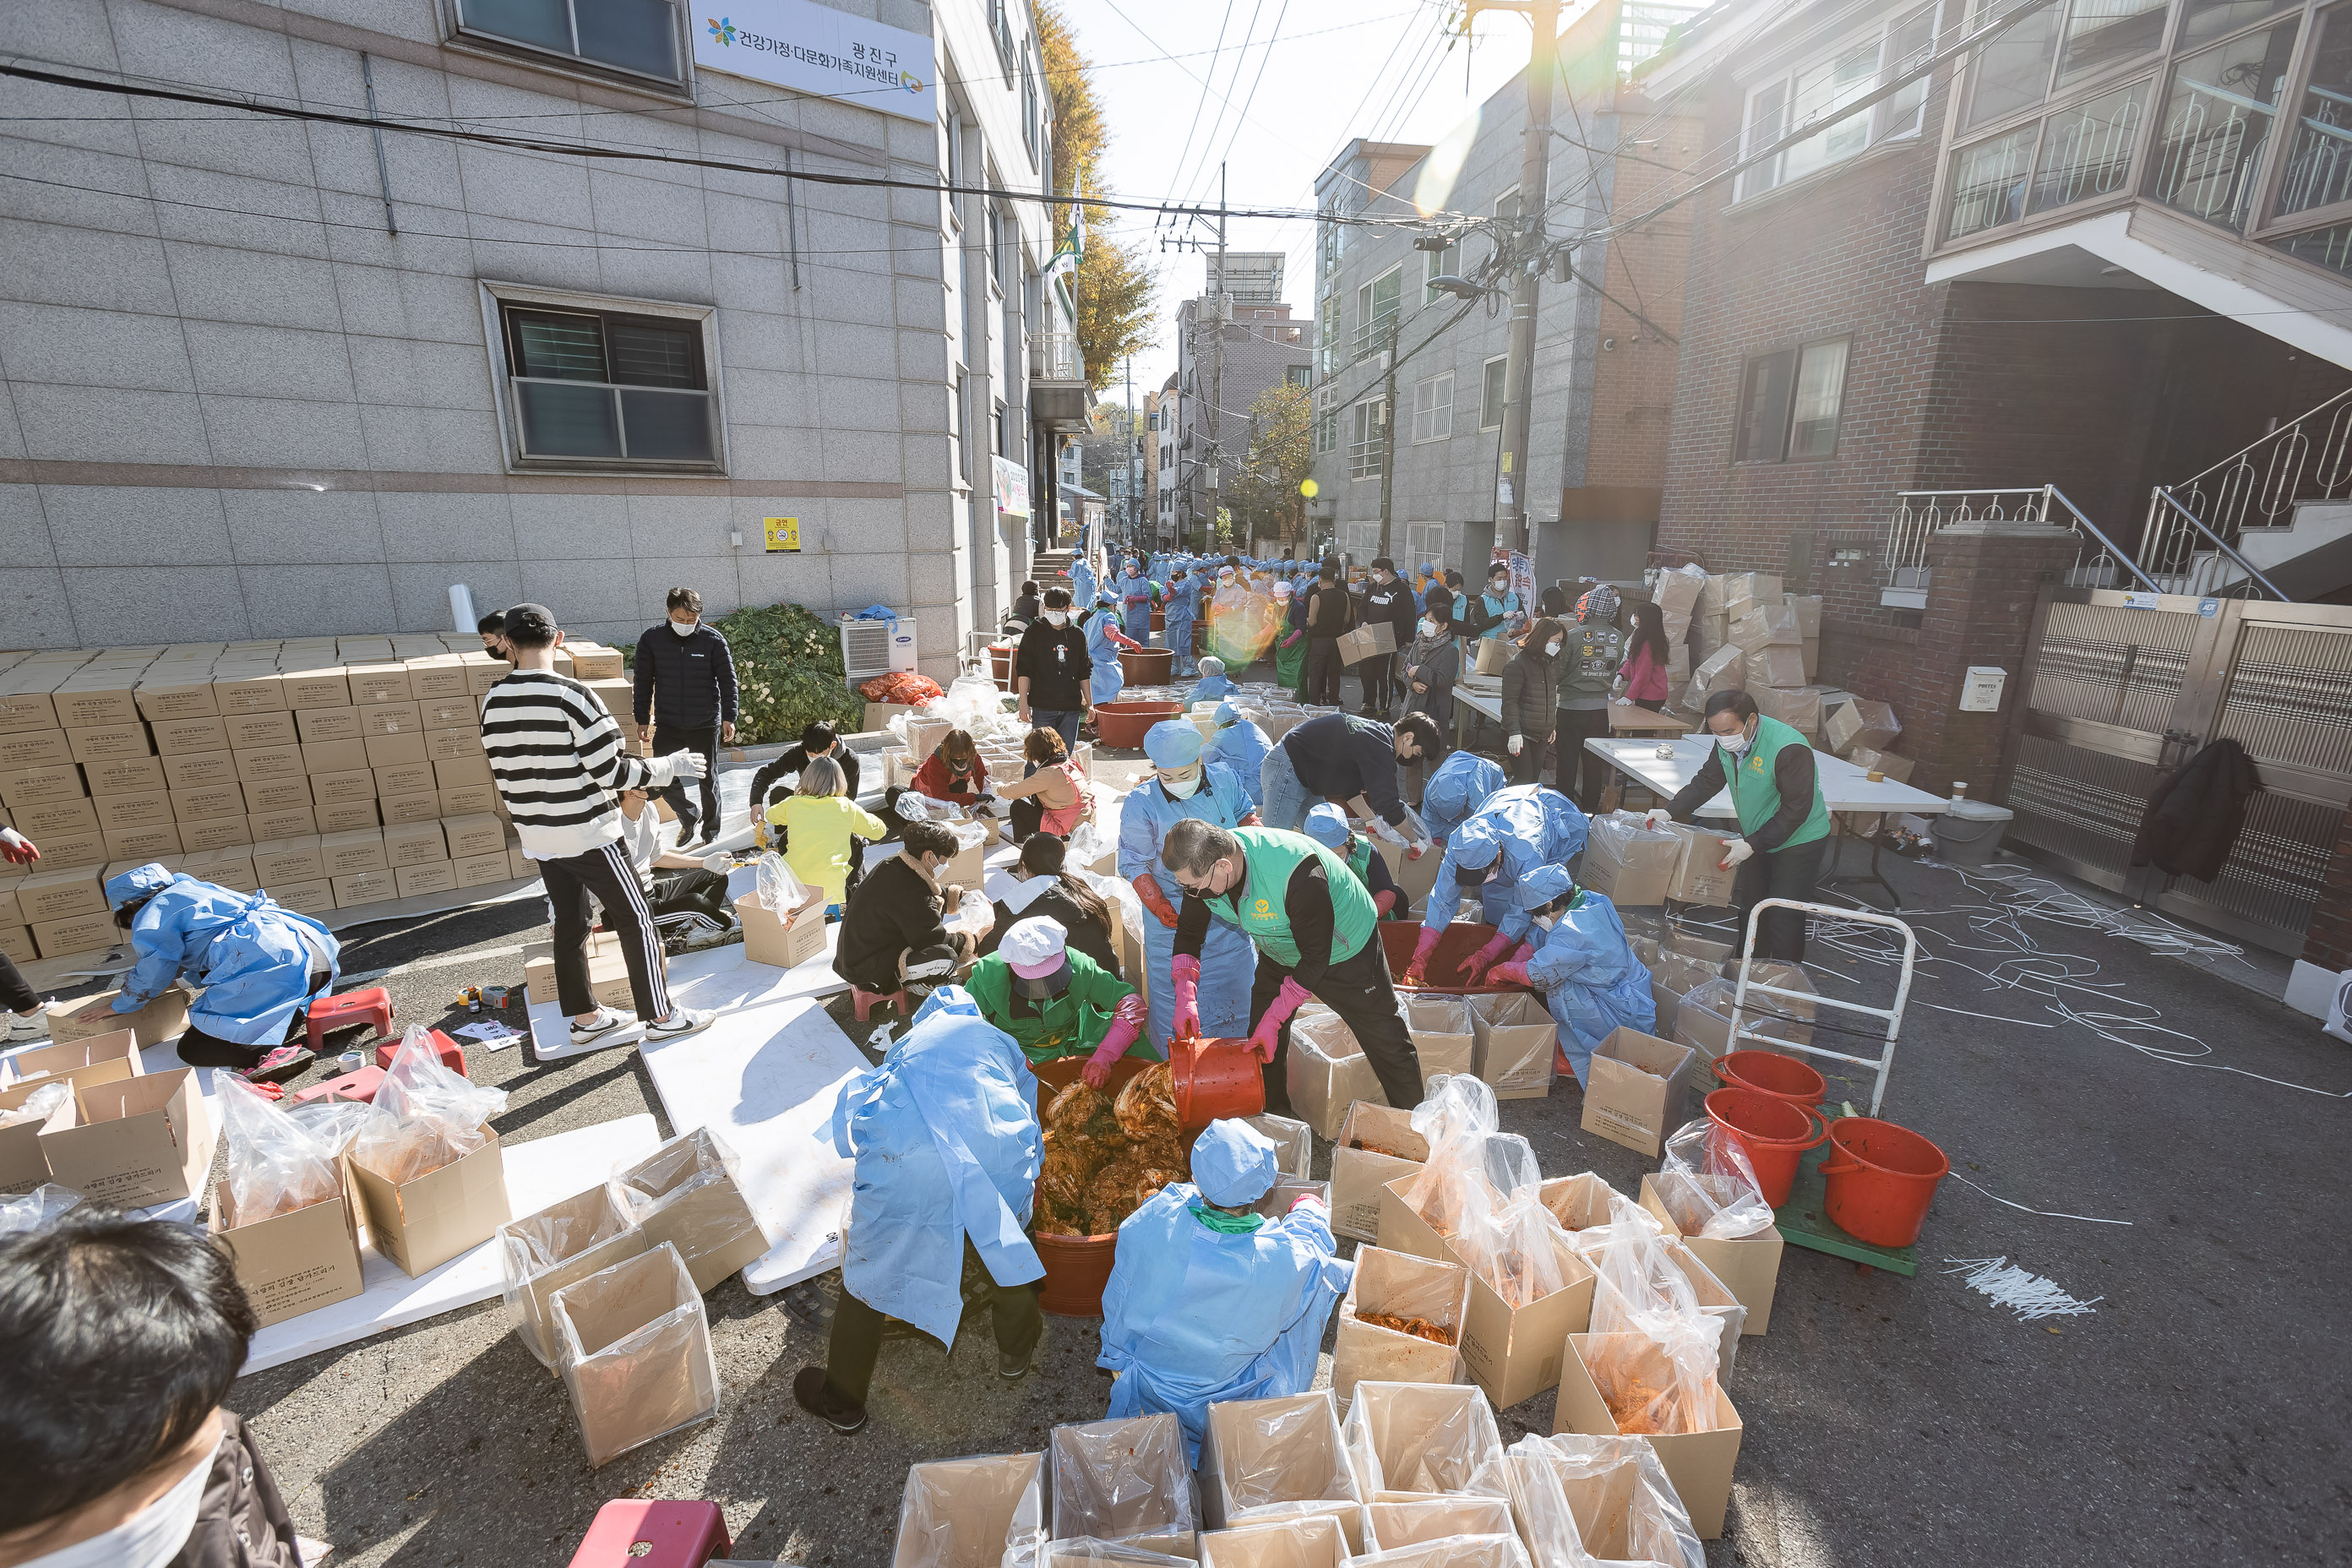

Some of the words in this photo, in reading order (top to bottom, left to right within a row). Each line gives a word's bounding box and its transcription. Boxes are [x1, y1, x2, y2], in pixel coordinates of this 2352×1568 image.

[738, 30, 899, 87] 건강가정·다문화가족지원센터
[1370, 595, 1390, 605] PUMA
[125, 1168, 162, 1181] 담가드리기
[252, 1285, 275, 1295] 사랑의
[278, 1279, 294, 1288] 김장
[297, 1265, 335, 1282] 담가드리기
